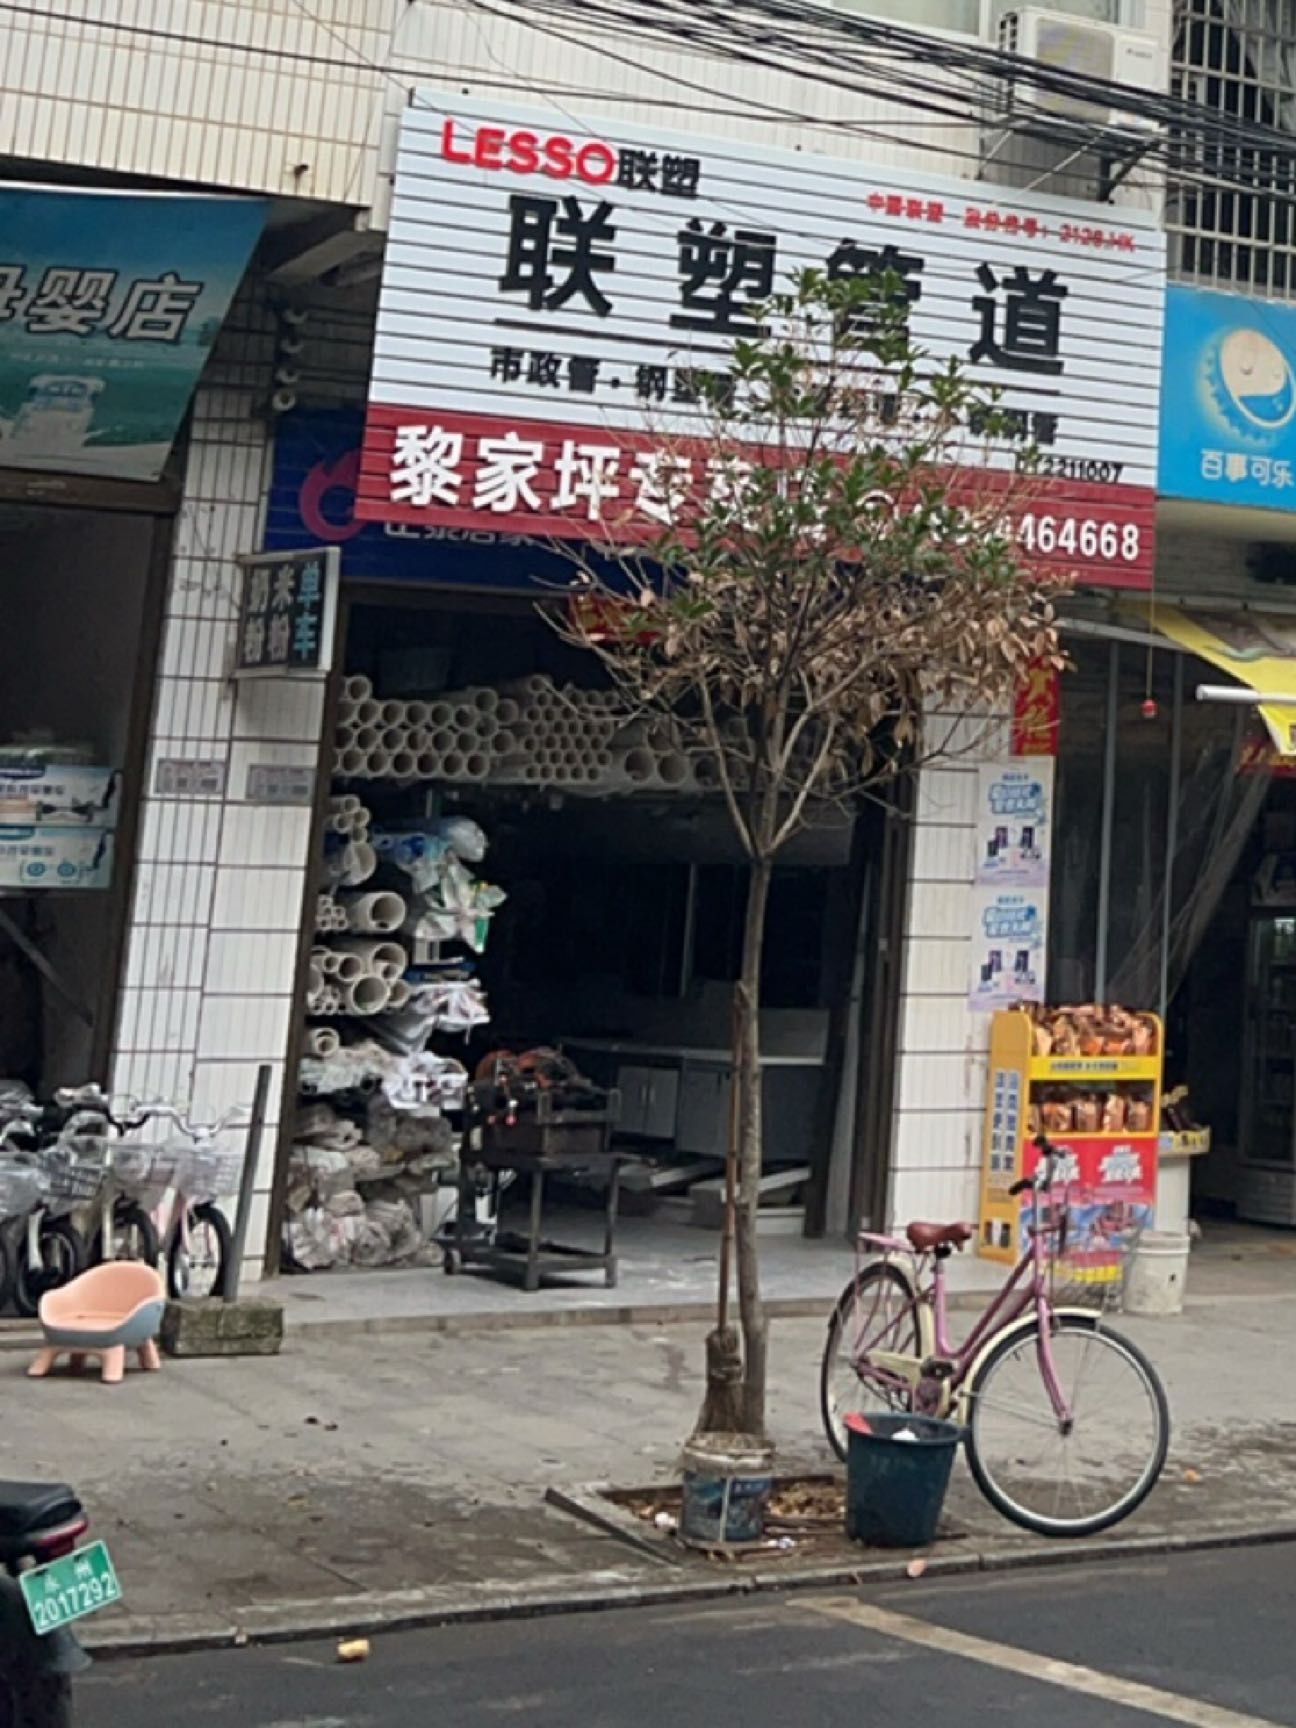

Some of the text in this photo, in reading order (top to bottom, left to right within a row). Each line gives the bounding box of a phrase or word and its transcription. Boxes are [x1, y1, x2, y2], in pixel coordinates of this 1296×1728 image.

[441, 118, 701, 199] LESSO 联塑
[498, 194, 1069, 376] 联塑管道
[1200, 449, 1295, 489] 百事可乐
